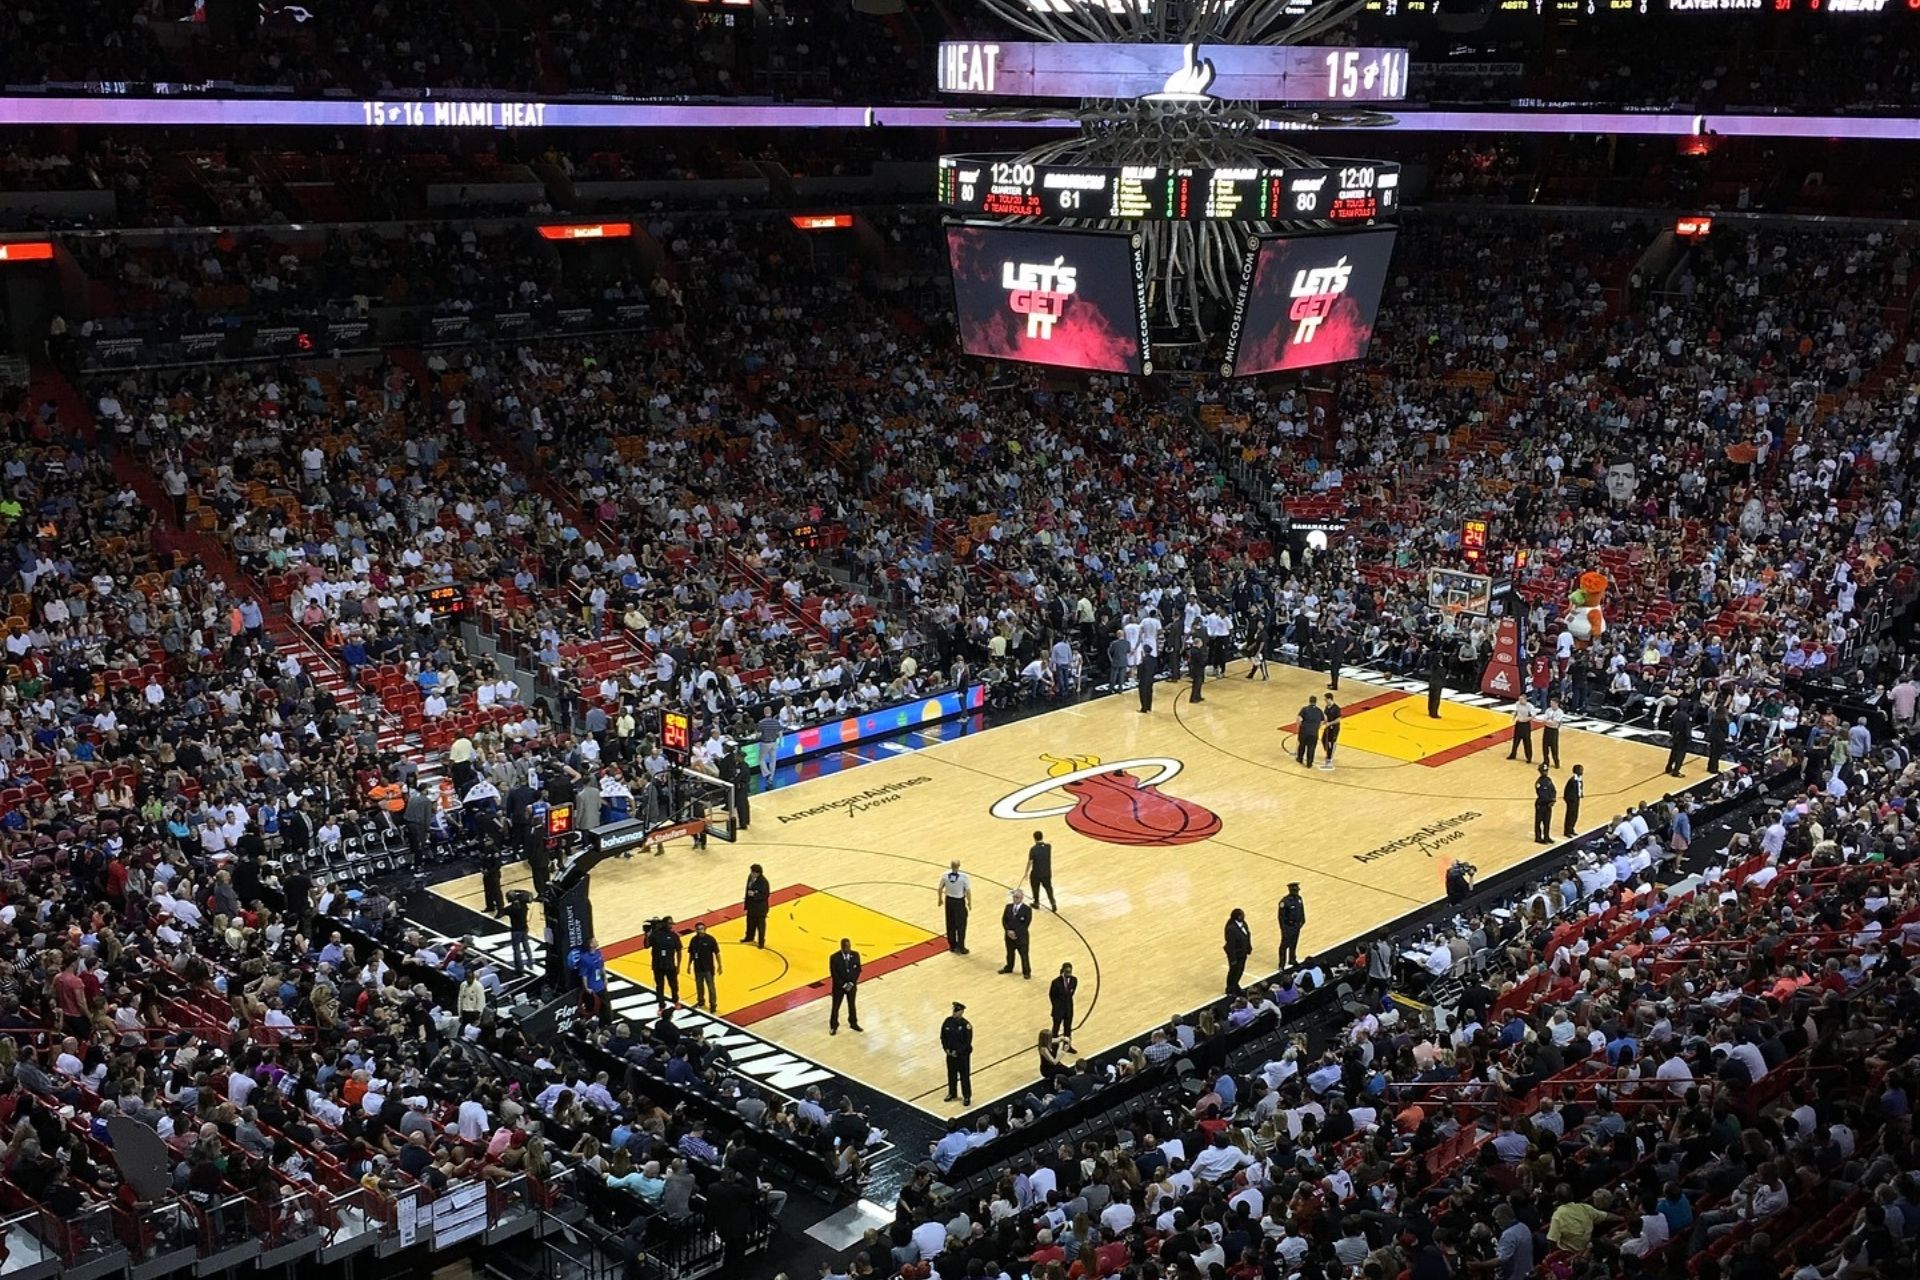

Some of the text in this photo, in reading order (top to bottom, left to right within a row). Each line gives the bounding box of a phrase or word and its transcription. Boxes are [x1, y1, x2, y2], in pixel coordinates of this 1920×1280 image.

[1501, 1, 1528, 10] ASSTS
[947, 44, 1000, 92] HEAT
[1326, 49, 1400, 98] 15 16
[363, 101, 546, 126] 15 16 MIAMI HEAT
[990, 163, 1035, 185] 12:00
[1339, 167, 1375, 188] 12:00
[961, 184, 974, 201] 80
[1059, 190, 1080, 208] 61
[1296, 192, 1317, 211] 80
[1383, 190, 1392, 206] 61
[1002, 255, 1077, 294] LET'S
[1288, 255, 1353, 299] LET'S
[1009, 289, 1069, 317] GET
[1132, 249, 1153, 360] MICCOSUKEE.COM
[1224, 250, 1255, 364] MICCOSUKEE.COM
[1288, 292, 1340, 322] GET
[1027, 313, 1058, 341] IT
[1293, 314, 1323, 345] IT
[1465, 530, 1483, 546] 24
[665, 725, 685, 747] 24
[844, 793, 901, 818] Arena
[552, 818, 566, 832] 24
[601, 830, 644, 849] bahamas
[1418, 830, 1465, 857] Arena
[566, 905, 577, 947] MERCHANT
[575, 918, 583, 946] GROUP
[1343, 1181, 1351, 1198] 7
